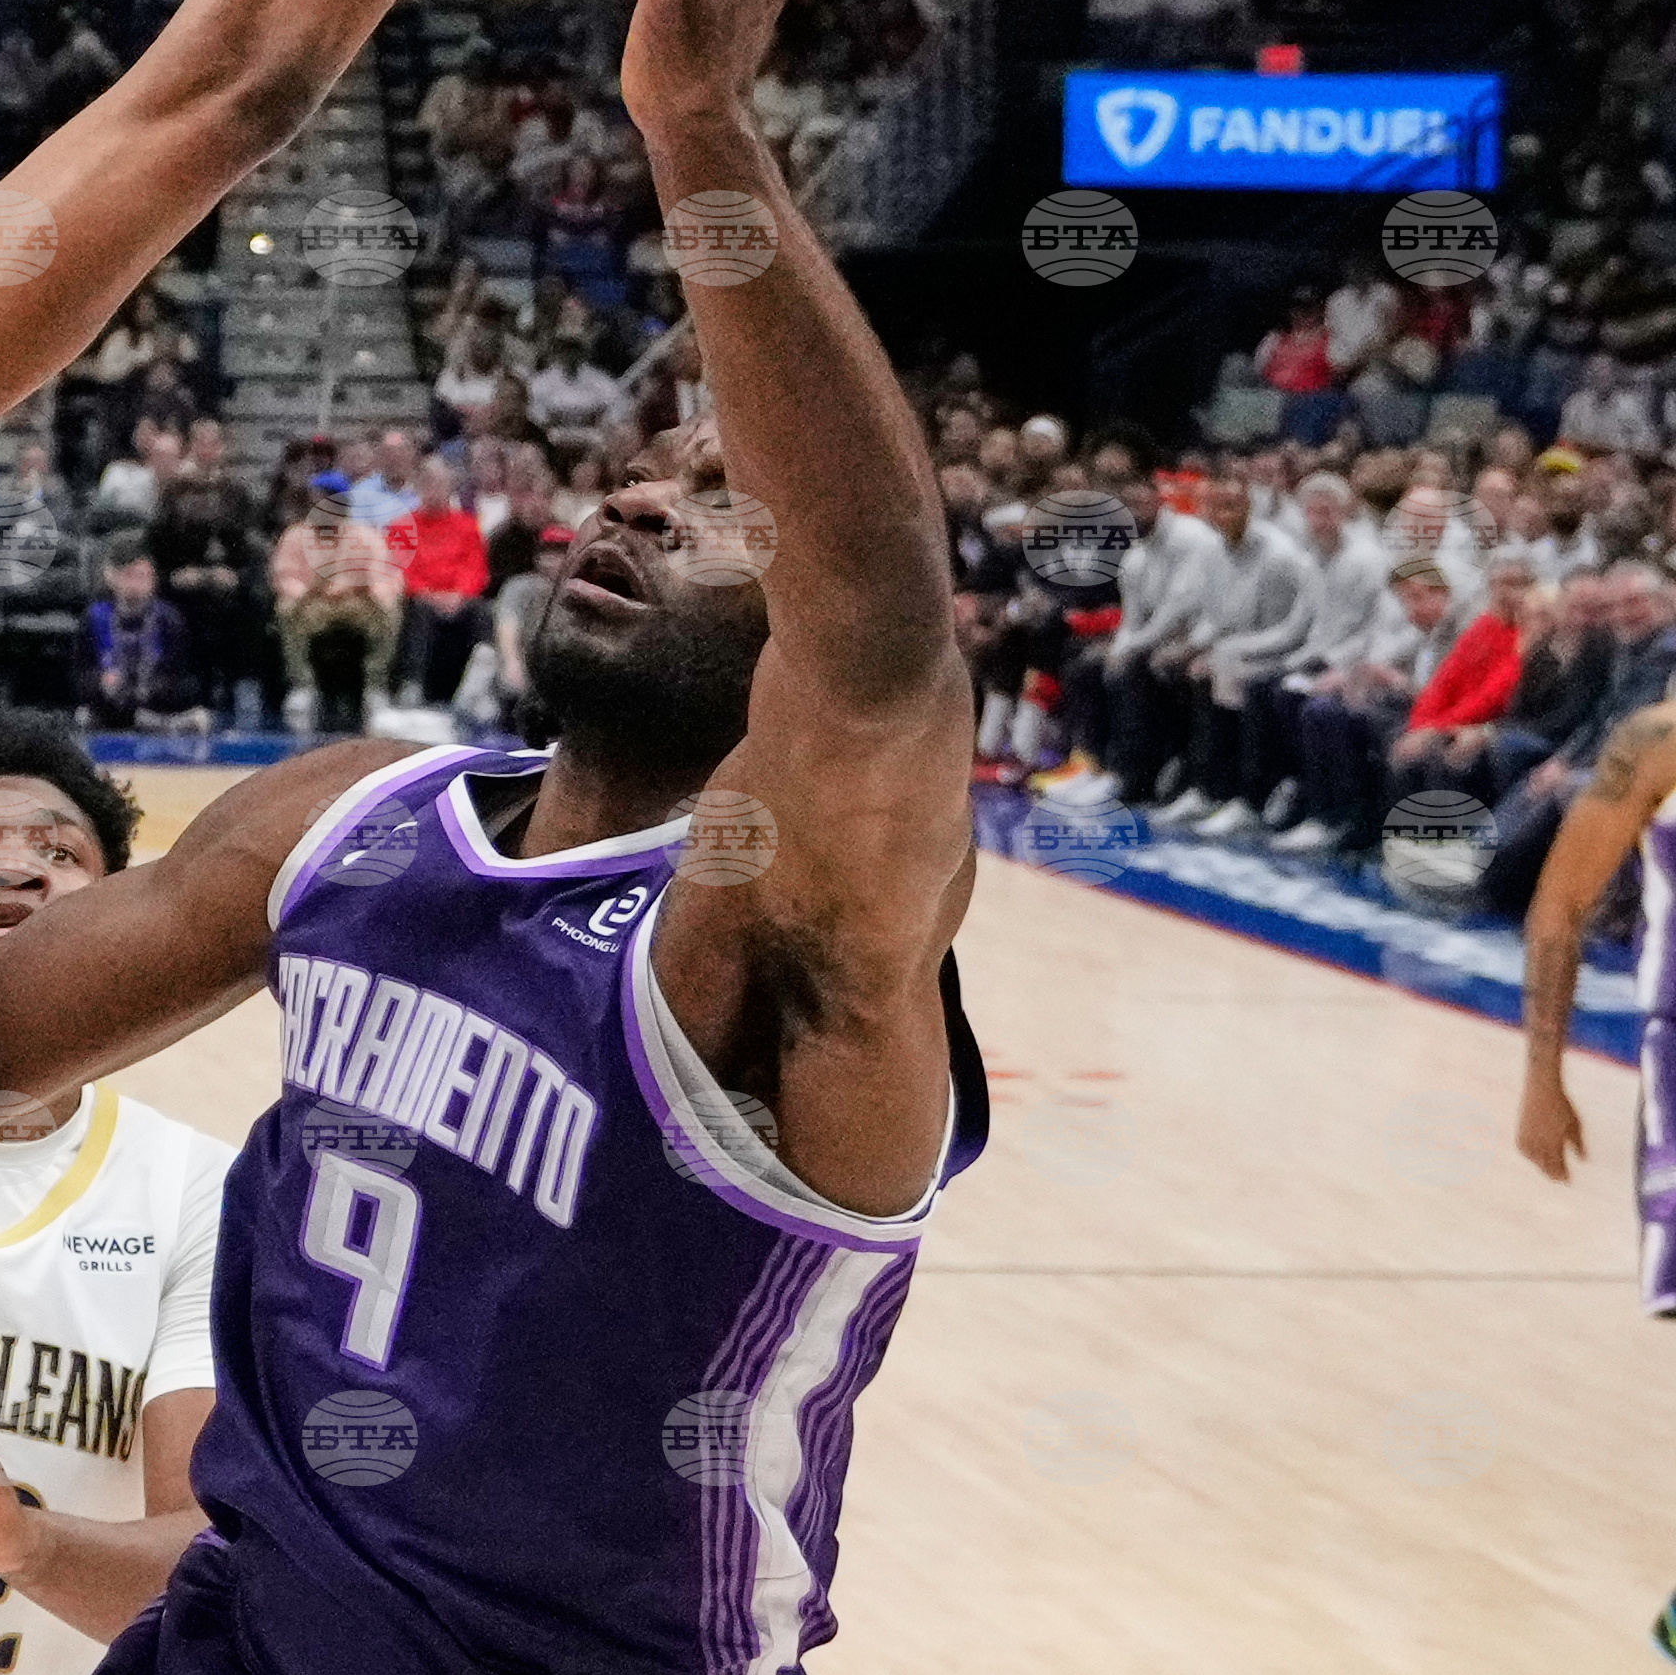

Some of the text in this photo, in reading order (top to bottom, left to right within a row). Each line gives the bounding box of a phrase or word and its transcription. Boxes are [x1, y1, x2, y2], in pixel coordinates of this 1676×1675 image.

[62, 1233, 156, 1256] NEWAGE
[78, 1259, 133, 1272] GRILLS
[299, 1146, 423, 1372] 9
